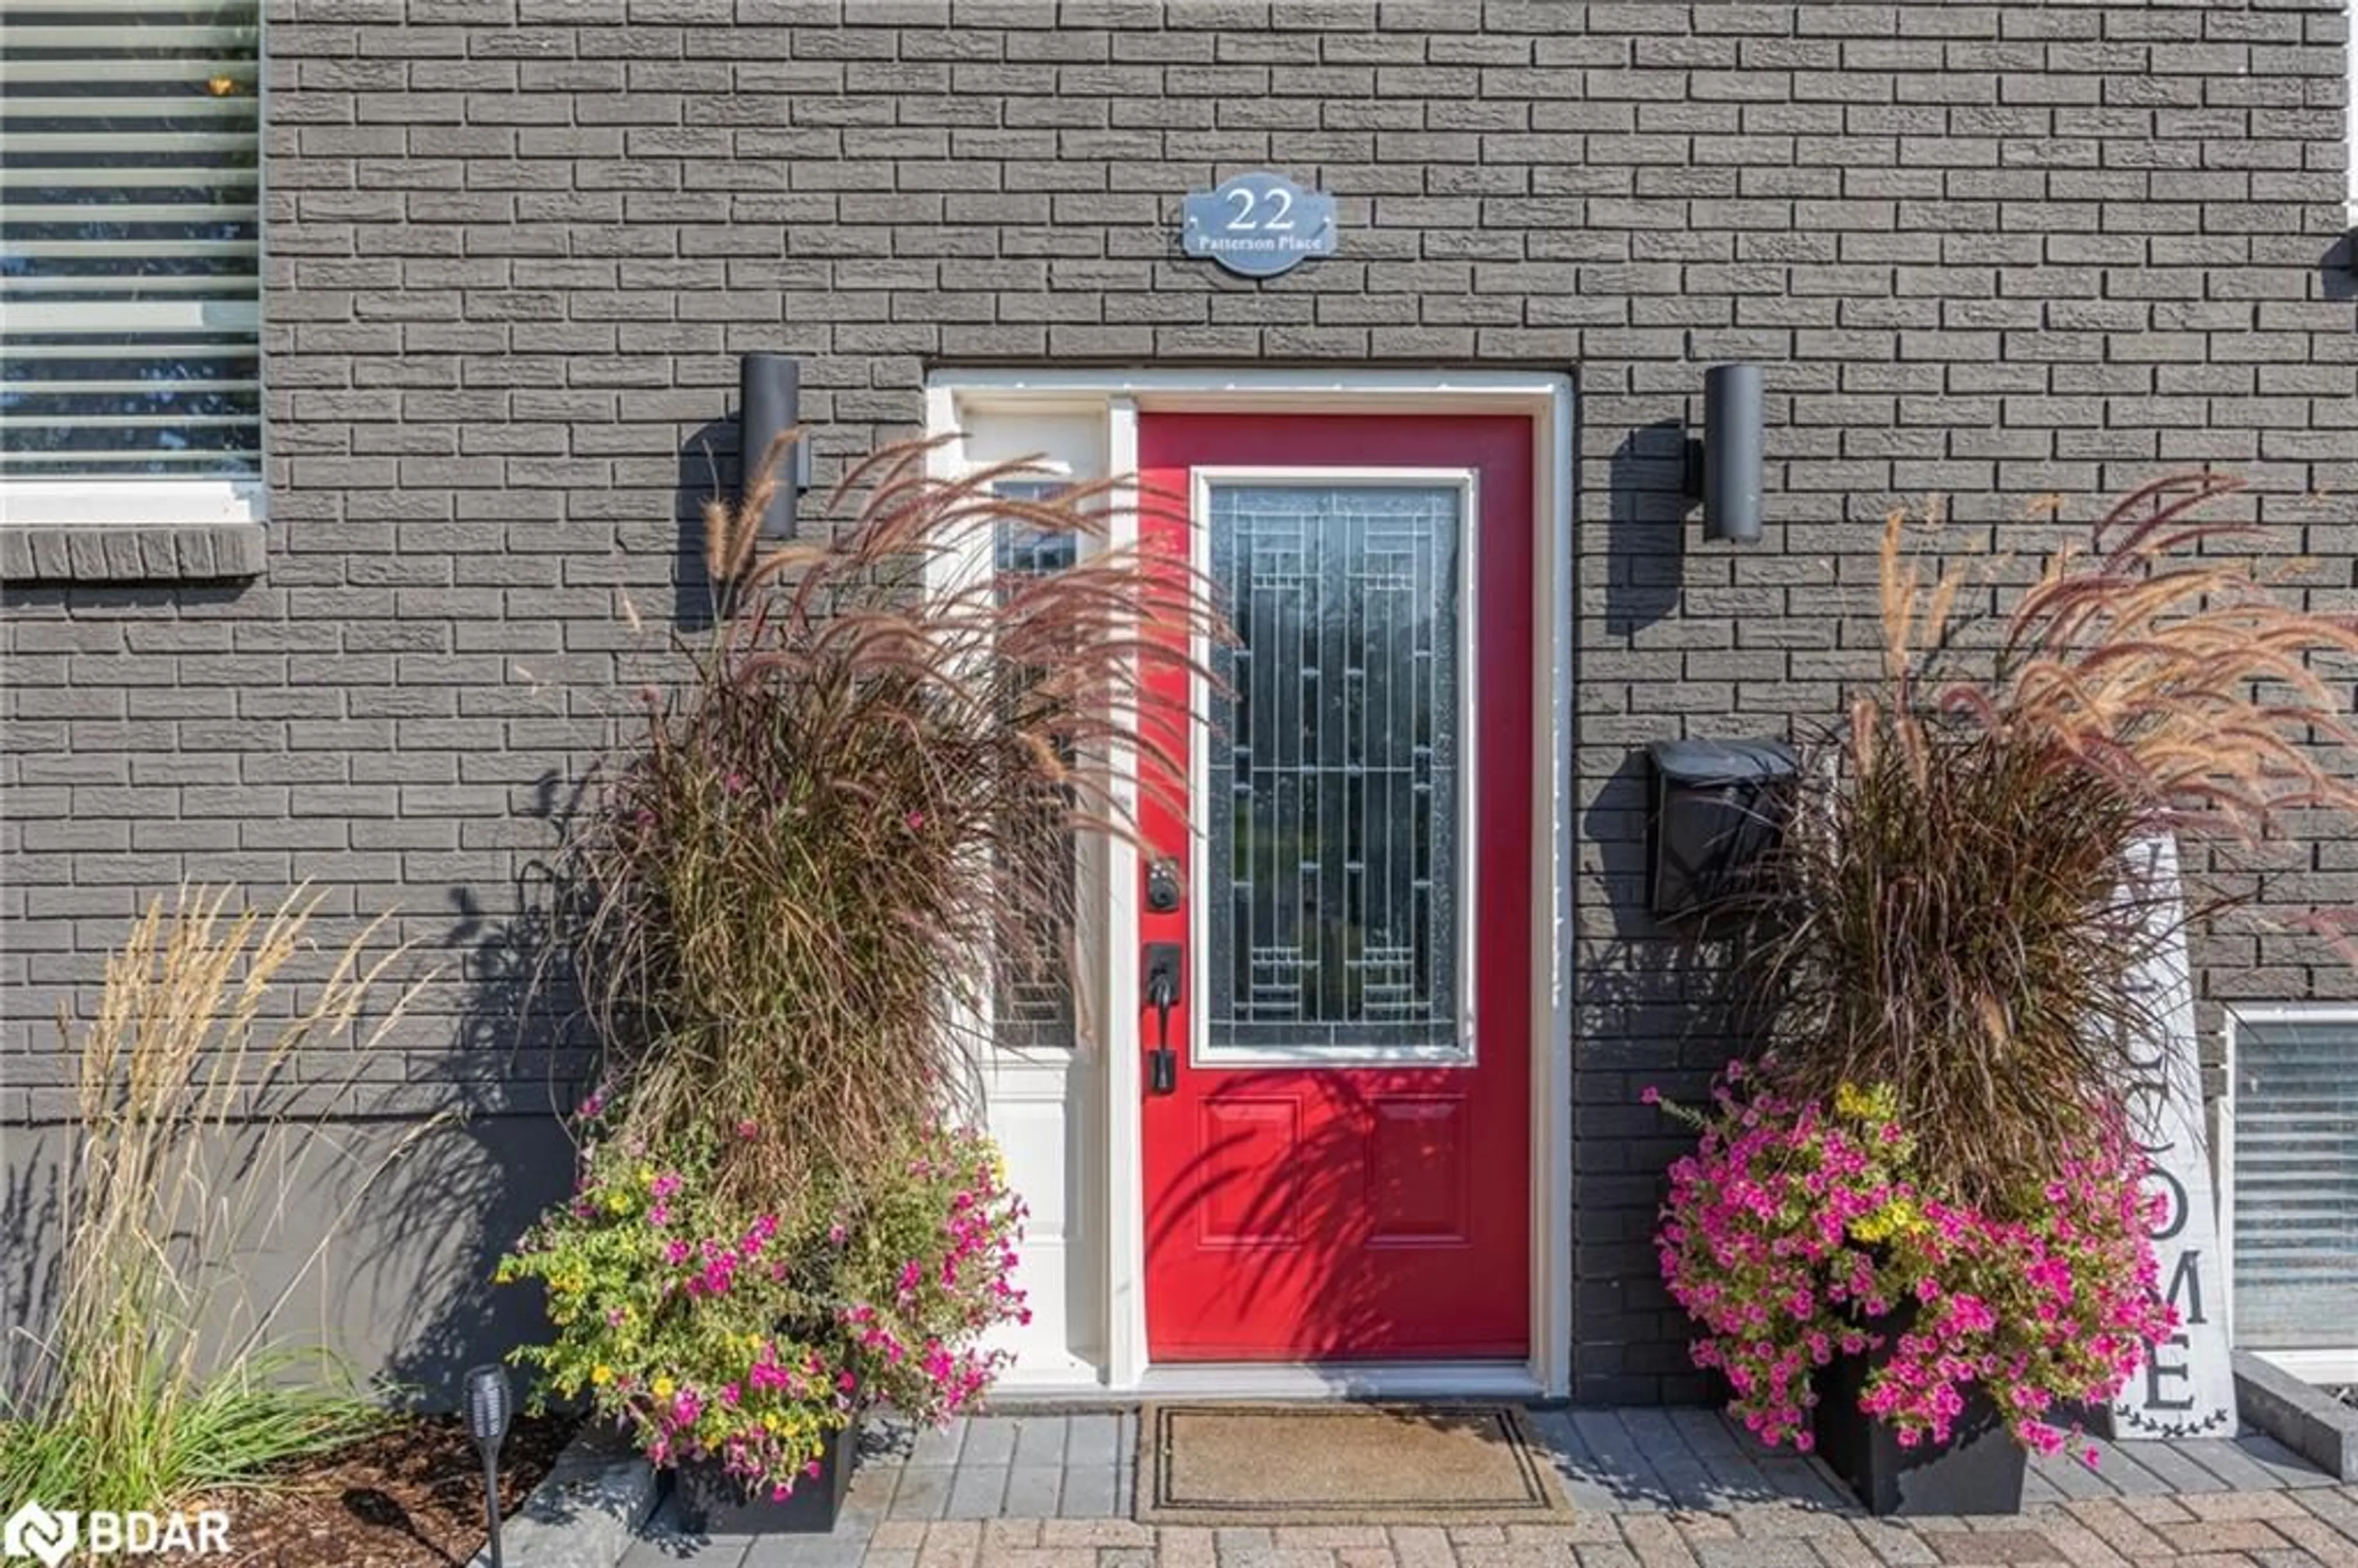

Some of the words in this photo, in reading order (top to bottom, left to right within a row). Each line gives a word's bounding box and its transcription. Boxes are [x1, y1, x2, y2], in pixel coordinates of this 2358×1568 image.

[1227, 188, 1294, 230] 22
[1198, 236, 1275, 251] Patterson
[1278, 235, 1322, 250] Place
[2106, 842, 2208, 1410] LCOME
